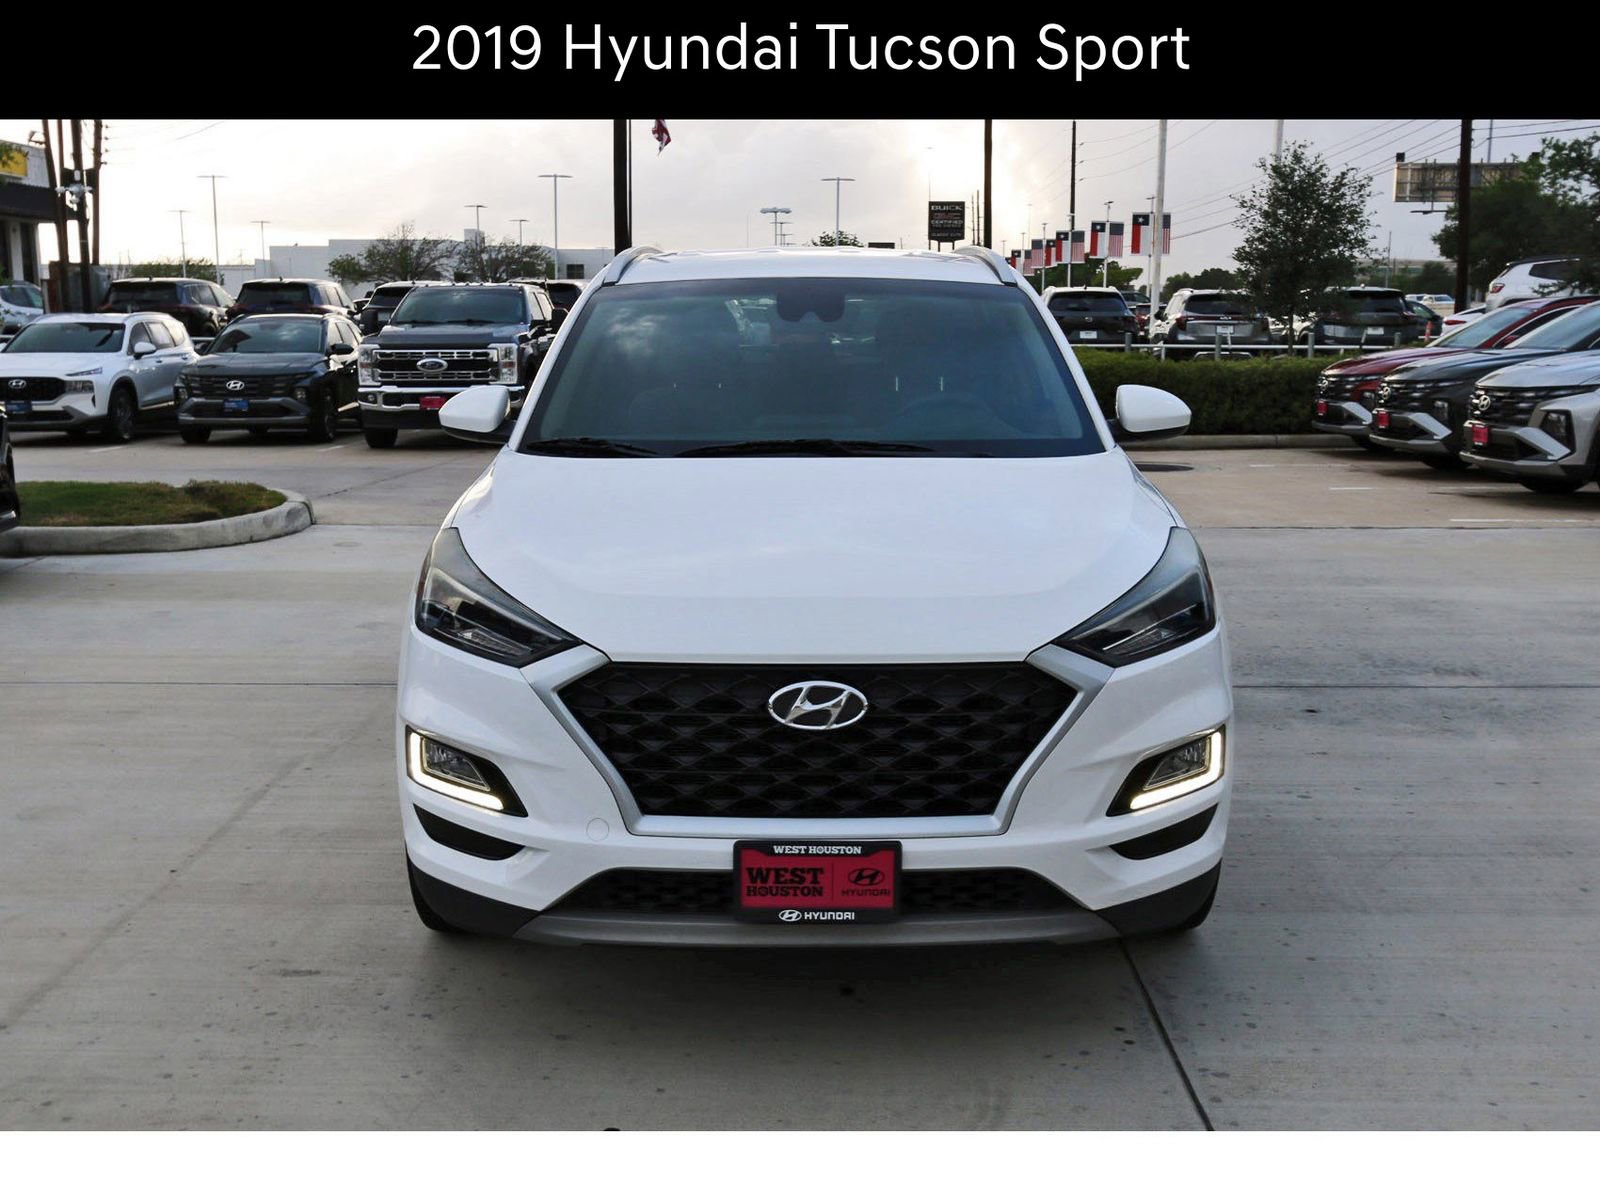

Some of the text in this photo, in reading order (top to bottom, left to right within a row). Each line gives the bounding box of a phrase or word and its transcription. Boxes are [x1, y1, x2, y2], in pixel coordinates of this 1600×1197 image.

[773, 845, 862, 855] WEST HOUSTON
[746, 867, 824, 885] WEST
[746, 886, 823, 897] HOUSTON
[841, 888, 890, 896] HYUNDAI
[804, 911, 855, 921] HYUNDAI
